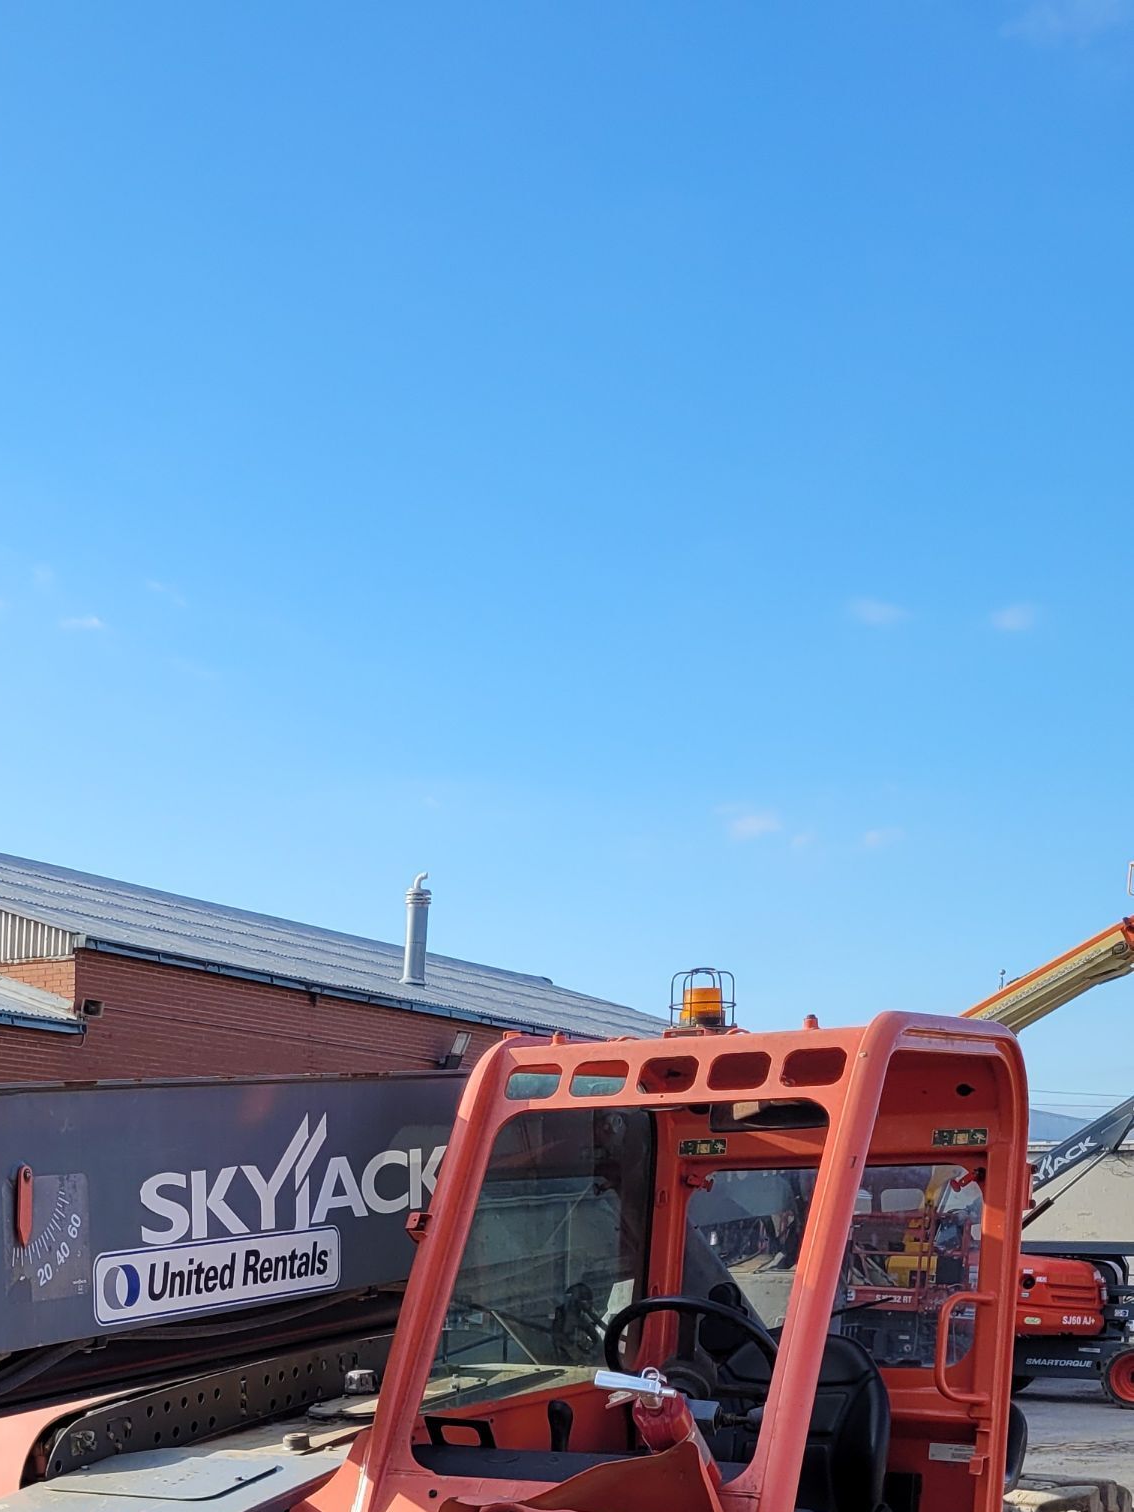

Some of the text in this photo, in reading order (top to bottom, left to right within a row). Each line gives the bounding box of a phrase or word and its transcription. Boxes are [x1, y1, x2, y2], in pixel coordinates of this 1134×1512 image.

[1032, 1136, 1097, 1185] YJACK
[140, 1112, 447, 1245] SKYJACK
[67, 1213, 81, 1239] 60
[56, 1241, 70, 1266] 40
[37, 1263, 53, 1287] 20
[147, 1241, 329, 1301] United Rentals
[1026, 1358, 1093, 1368] SMARTORQUE
